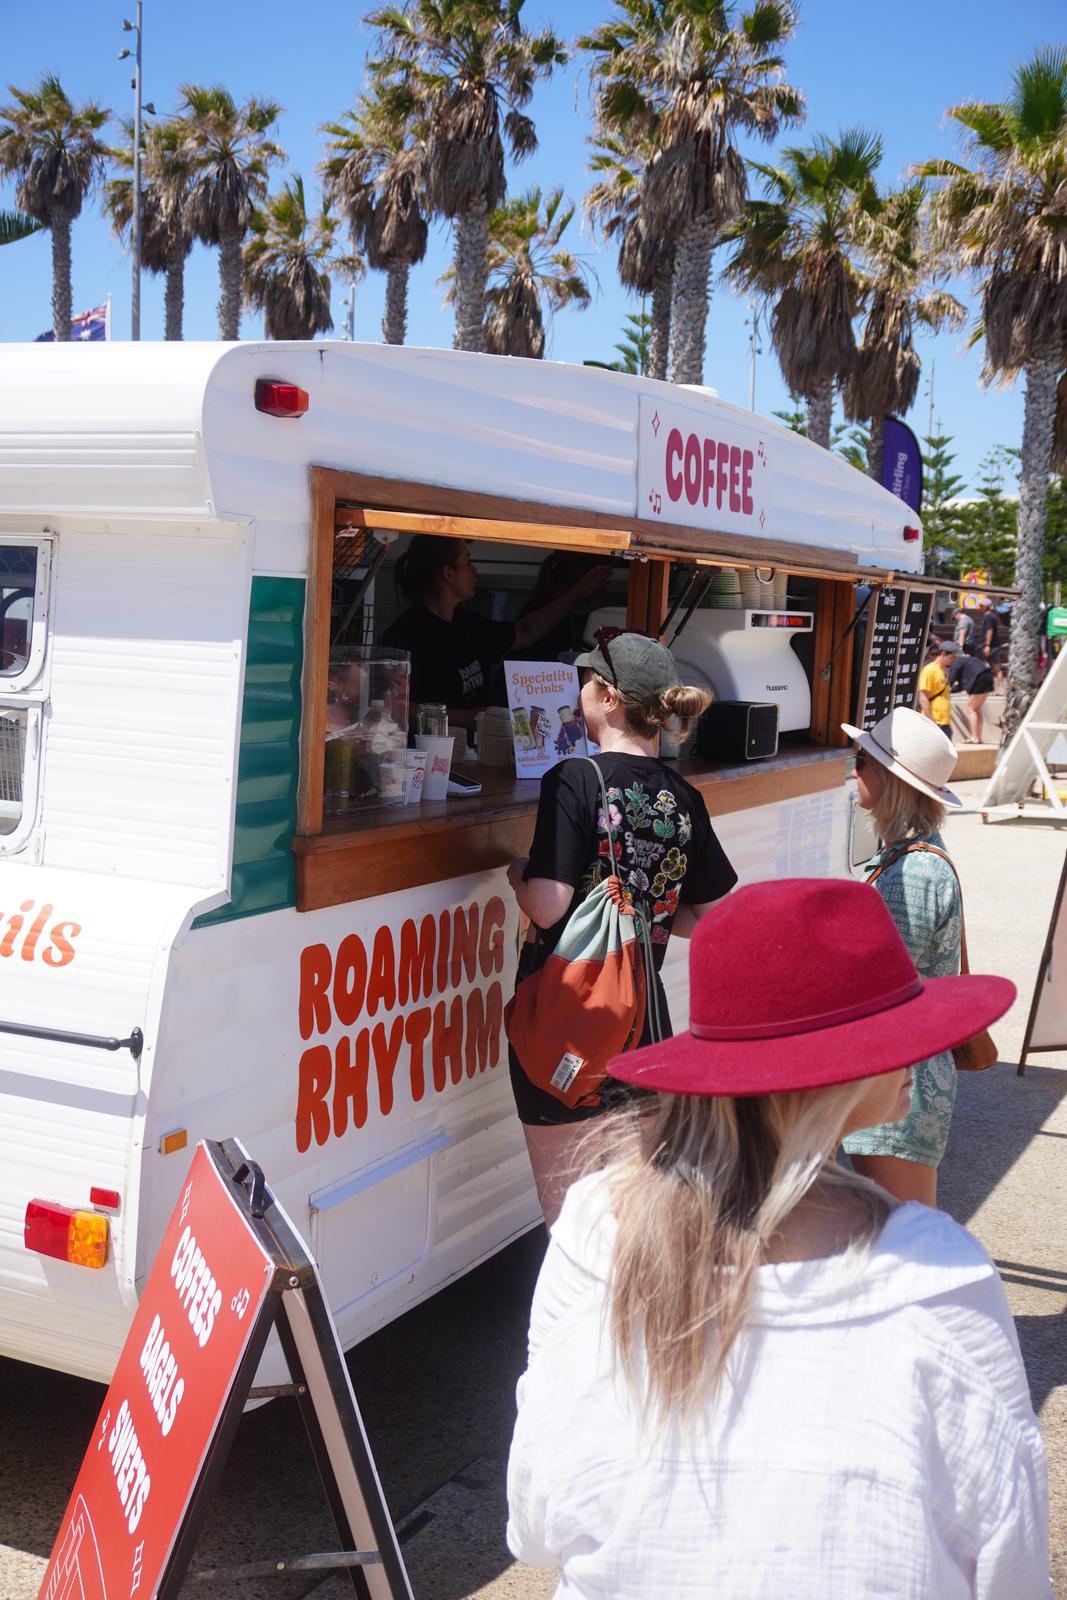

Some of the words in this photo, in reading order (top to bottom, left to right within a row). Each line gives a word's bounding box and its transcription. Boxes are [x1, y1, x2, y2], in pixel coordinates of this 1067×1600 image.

[665, 427, 754, 516] COFFEE
[512, 670, 574, 687] Speciality
[526, 683, 565, 696] Drinks
[0, 899, 82, 968] ils
[298, 895, 506, 1041] ROAMING
[295, 981, 503, 1154] RHYTHM
[170, 1225, 223, 1348] COFFEES
[139, 1313, 185, 1437] BAGELS
[108, 1398, 151, 1534] SWEETS
